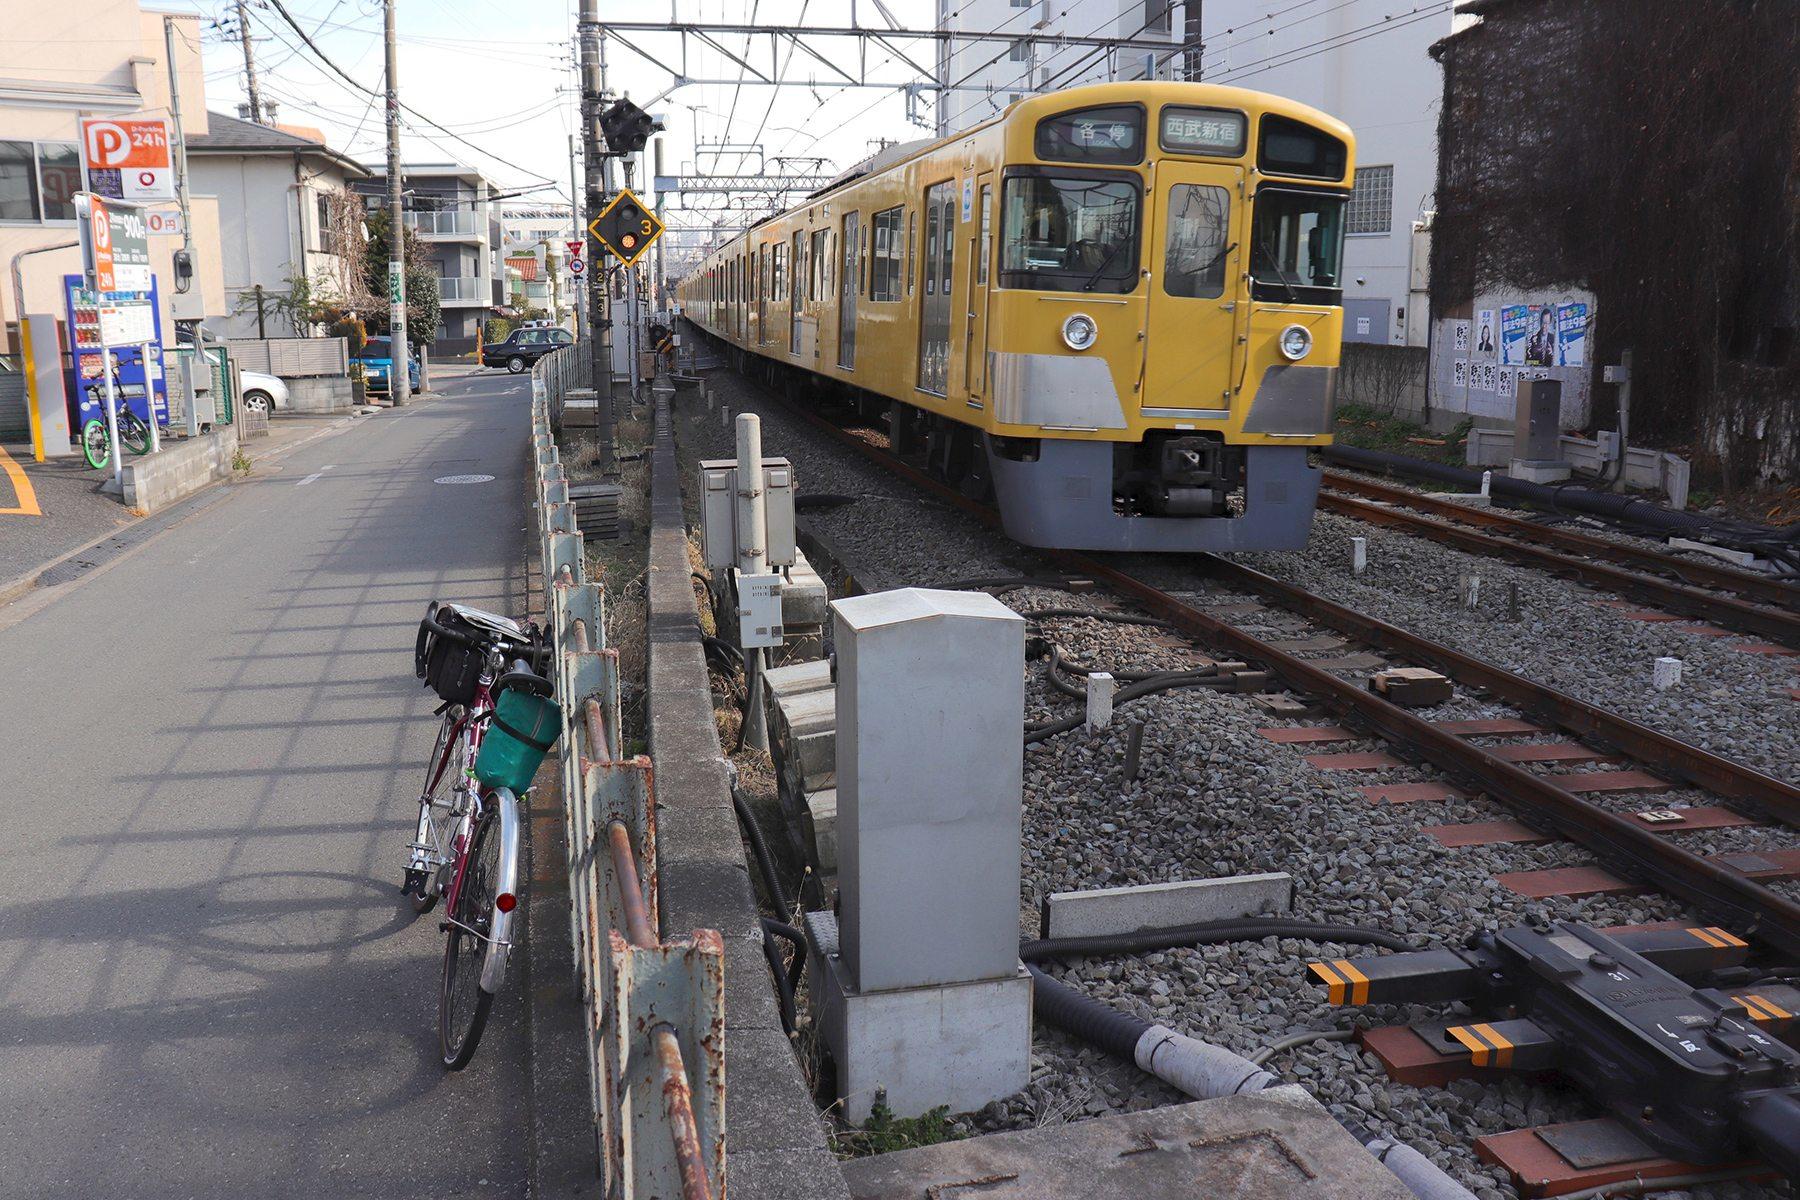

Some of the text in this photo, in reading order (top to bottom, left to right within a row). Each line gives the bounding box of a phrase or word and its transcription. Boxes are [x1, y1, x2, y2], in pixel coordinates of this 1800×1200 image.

[1166, 117, 1237, 141] 西武新宿
[87, 122, 131, 165] P
[132, 133, 165, 147] 24h
[640, 219, 652, 235] 3
[1607, 971, 1631, 982] 31
